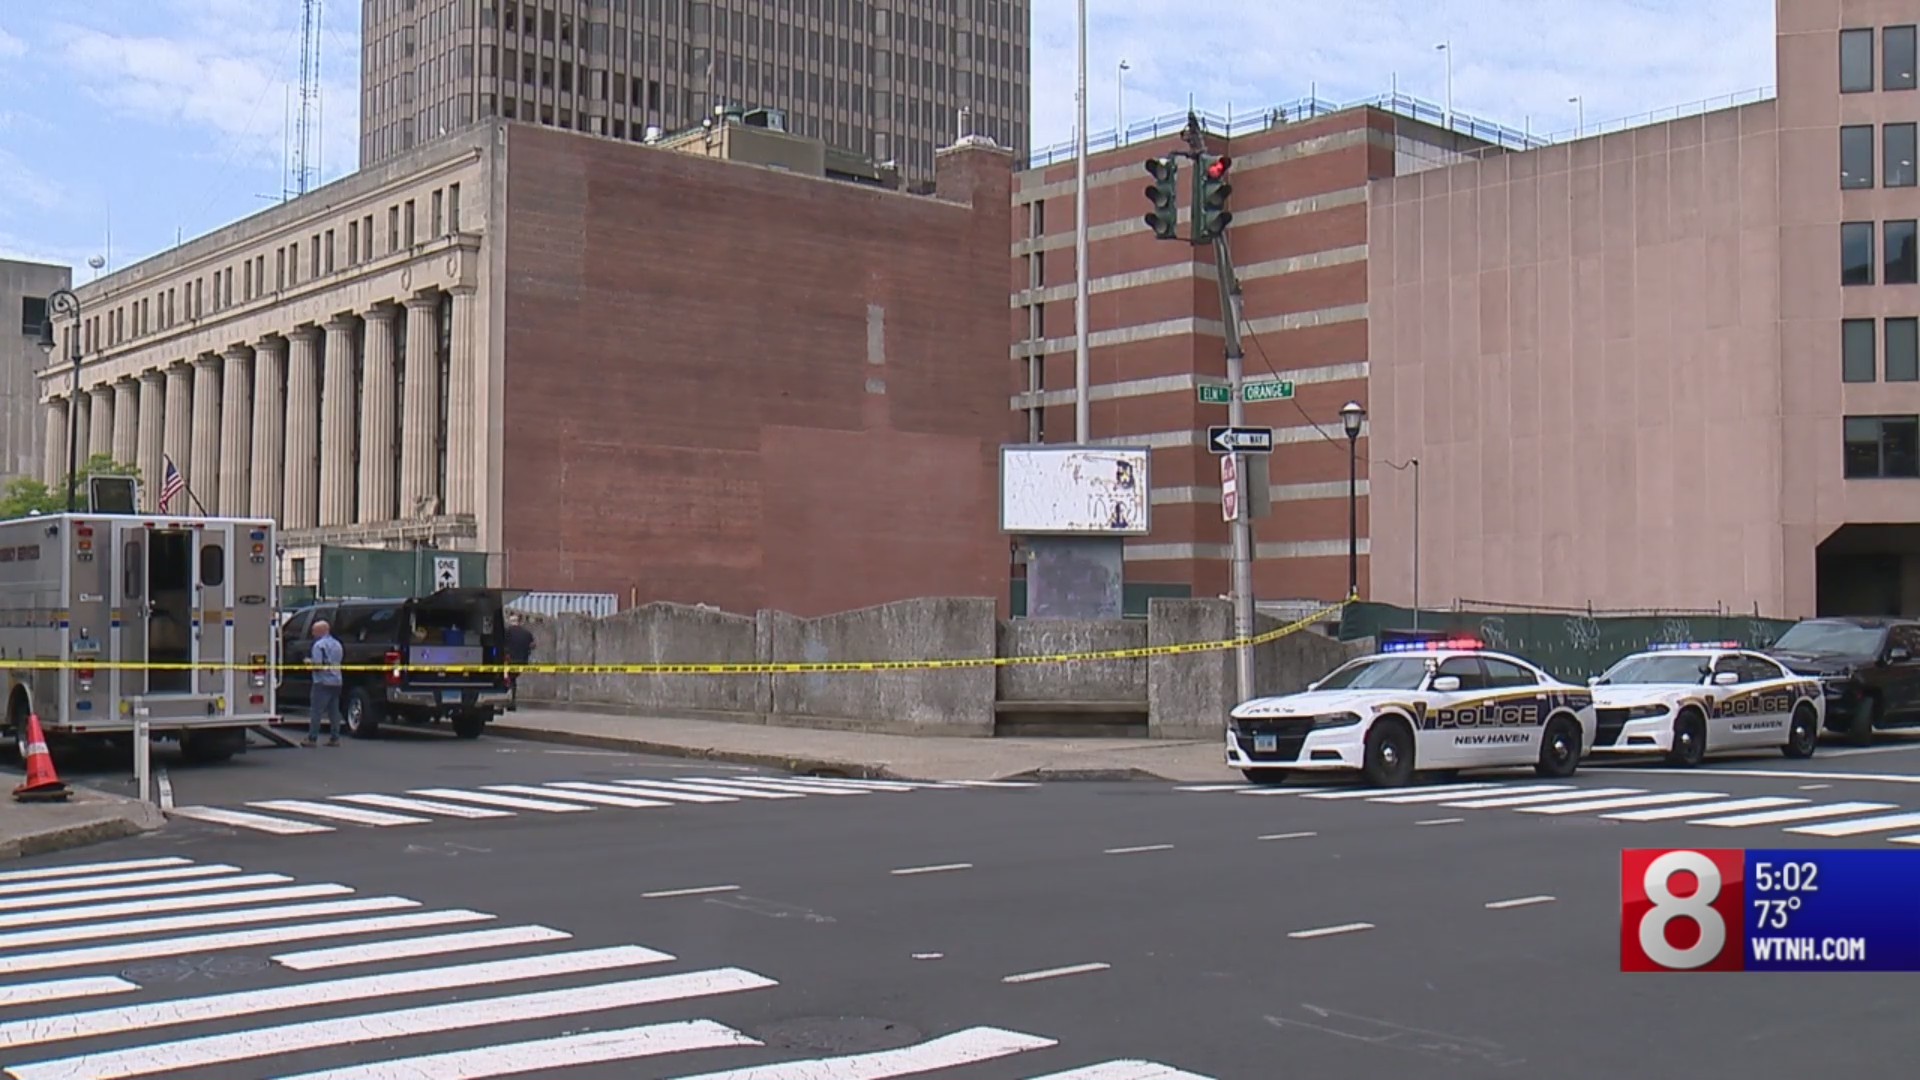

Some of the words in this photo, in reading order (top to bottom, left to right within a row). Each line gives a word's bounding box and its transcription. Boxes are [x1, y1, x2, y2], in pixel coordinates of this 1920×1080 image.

[1203, 386, 1219, 400] ELM
[1247, 383, 1283, 399] ORANGE
[1223, 434, 1240, 445] ONE
[1249, 435, 1263, 444] WAY
[437, 560, 455, 570] ONE
[1720, 696, 1789, 716] POLICE
[1436, 705, 1538, 729] POLICE
[1732, 722, 1752, 731] NEW
[1753, 720, 1783, 730] HAVEN
[1454, 735, 1485, 745] NEW
[1487, 734, 1530, 744] HAVEN
